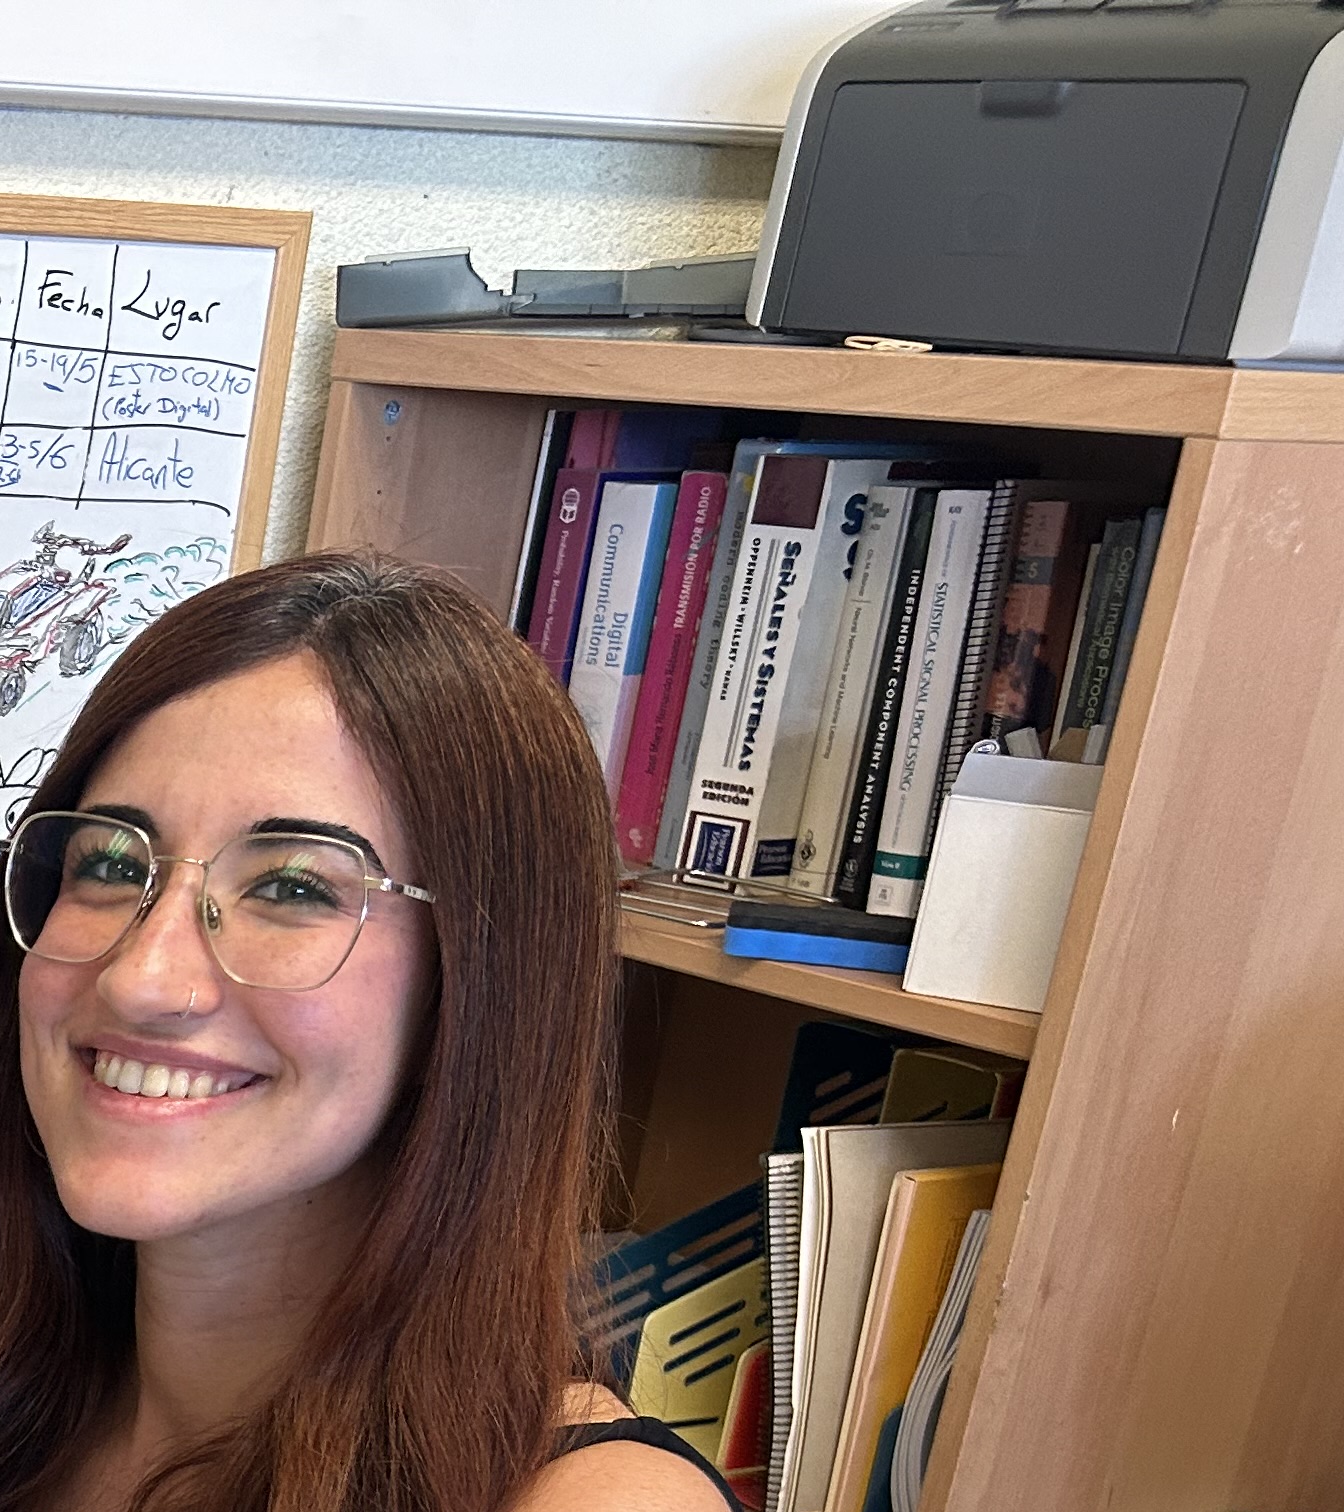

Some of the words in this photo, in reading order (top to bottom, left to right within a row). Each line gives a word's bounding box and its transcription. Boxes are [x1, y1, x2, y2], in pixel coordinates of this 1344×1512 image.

[38, 269, 104, 319] Fecha
[121, 269, 220, 340] Lugar
[107, 363, 251, 394] ESTOCOLMO
[99, 431, 193, 490] Alicante
[697, 486, 712, 522] RADIO
[690, 523, 706, 551] POR
[585, 523, 624, 666] Communications
[740, 537, 761, 605] OPPENHEIM
[1117, 546, 1136, 596] Color
[605, 611, 629, 668] Digital
[727, 613, 746, 663] WILLSKY
[893, 568, 921, 674] INDEPENDENT
[926, 582, 949, 656] STATISTICAL
[1098, 601, 1124, 658] Image
[917, 659, 934, 705] SIGNAL
[737, 661, 776, 772] SISTEMAS
[872, 677, 897, 769] COMPONENT
[700, 779, 755, 796] SEGUNDA
[852, 774, 876, 845] ANALYSIS
